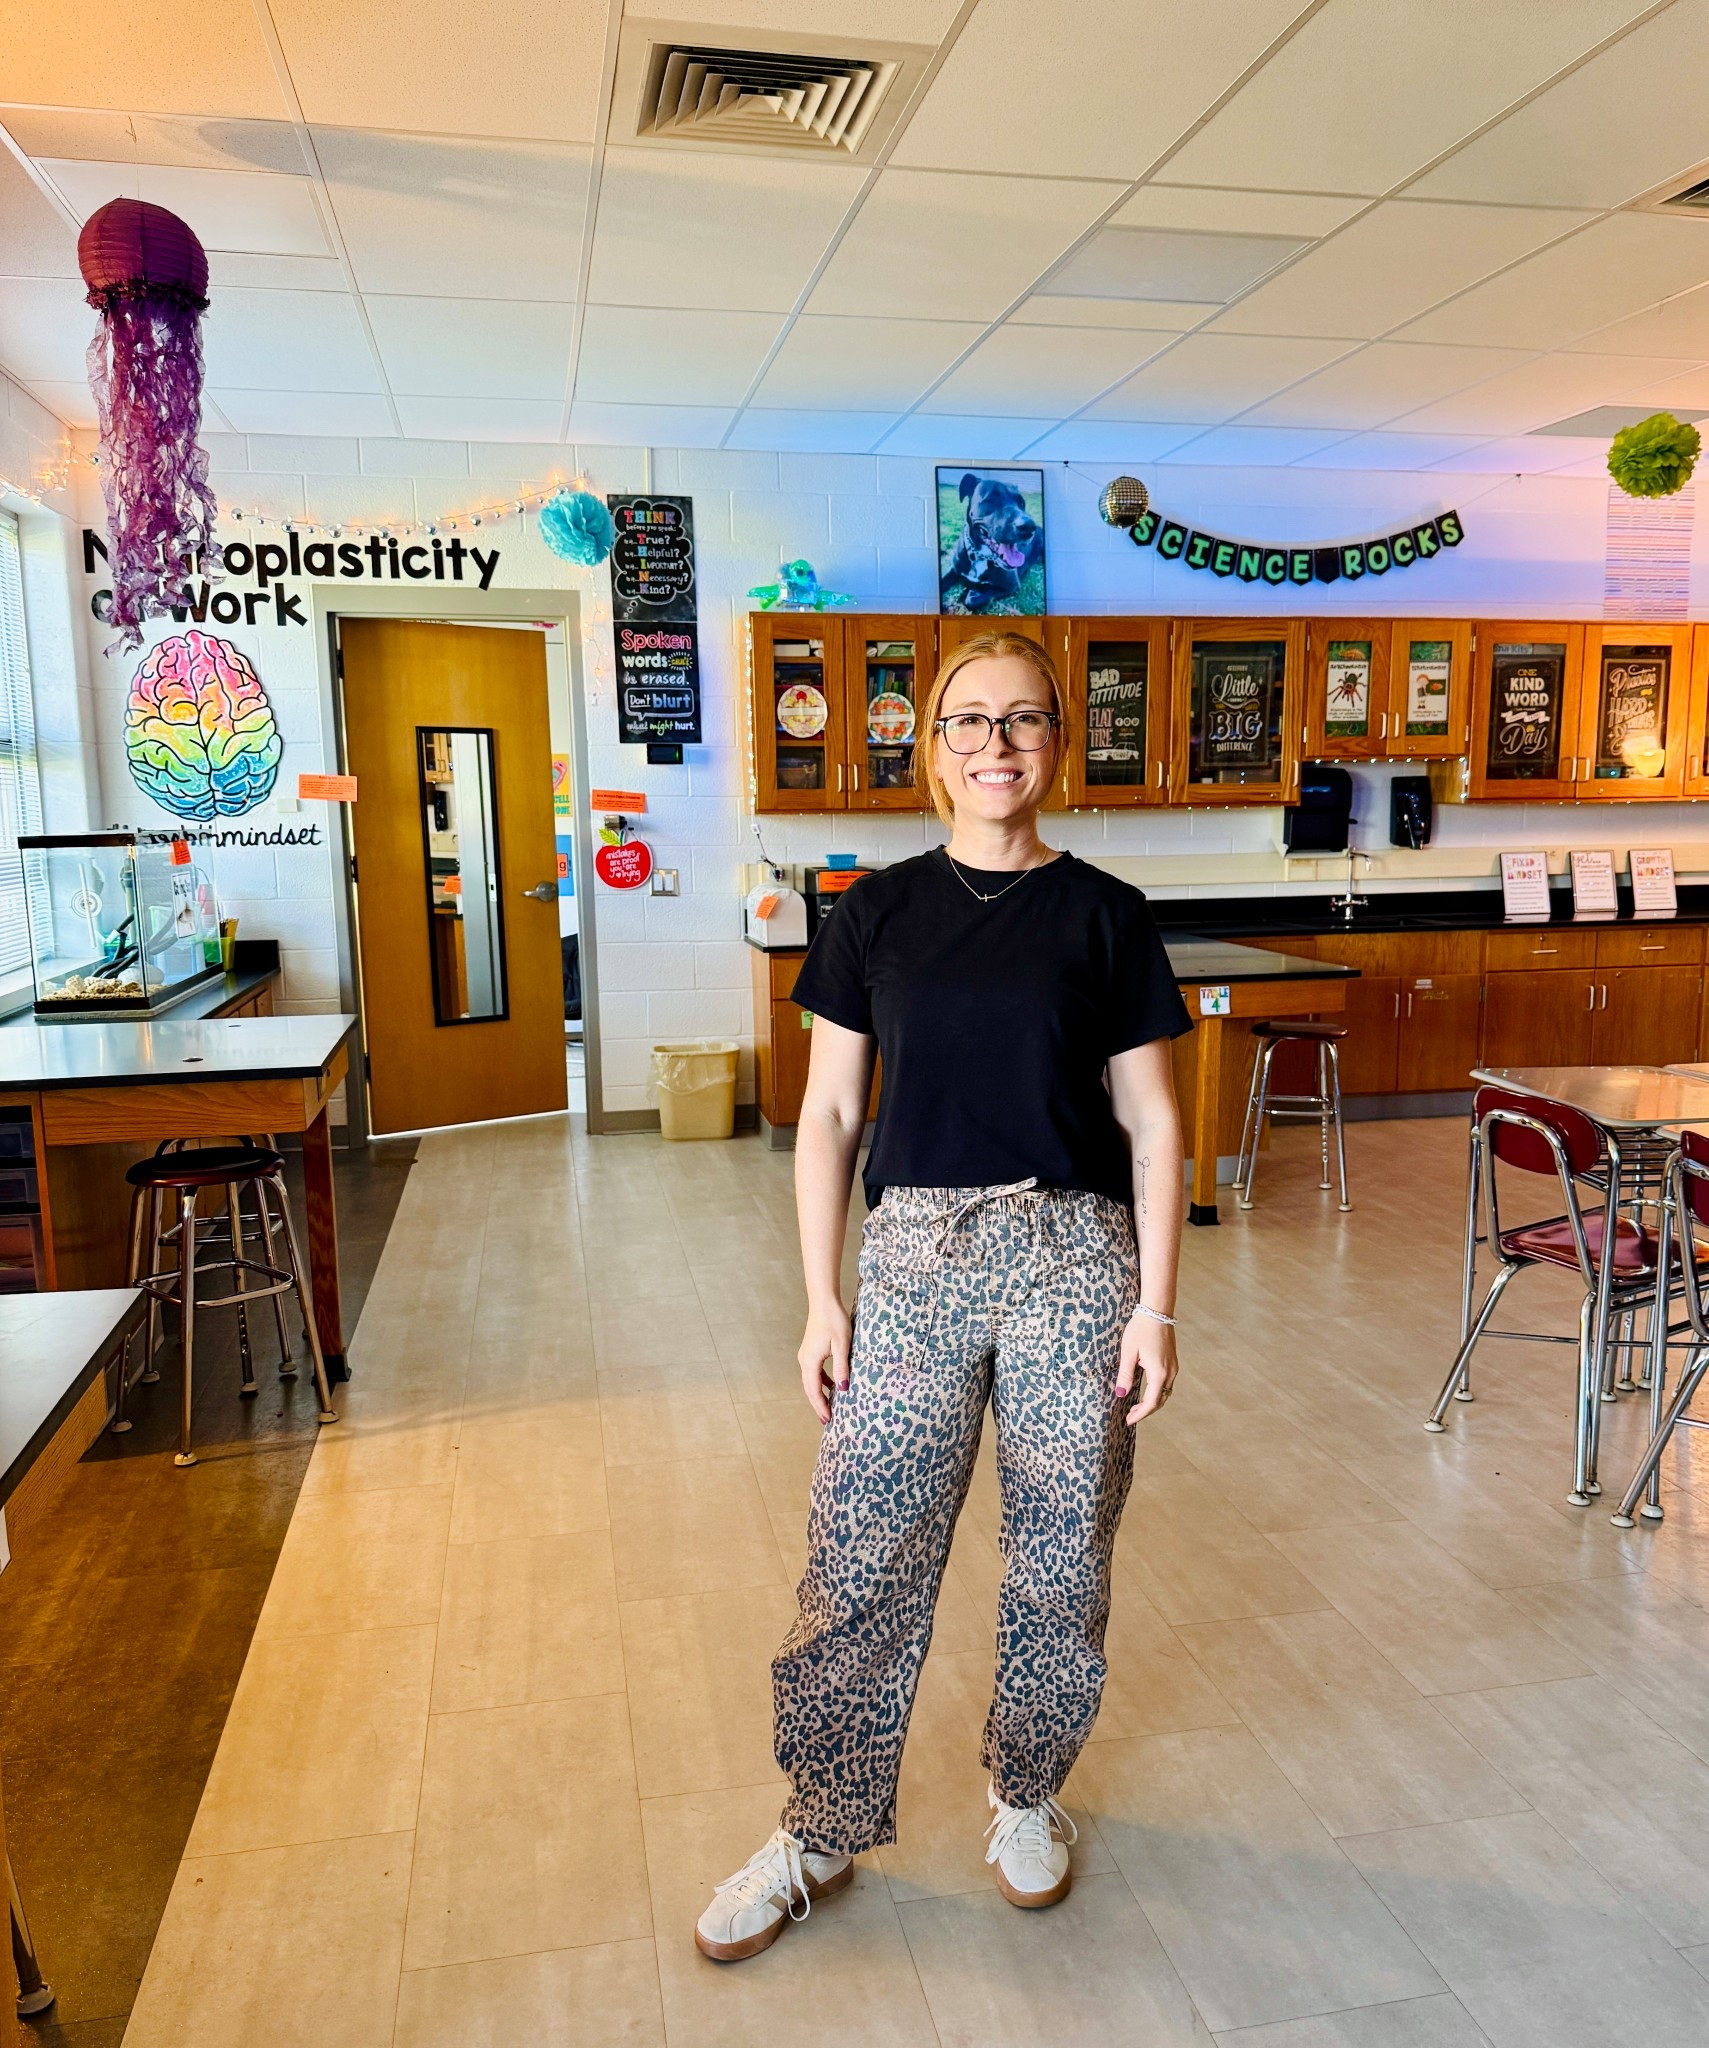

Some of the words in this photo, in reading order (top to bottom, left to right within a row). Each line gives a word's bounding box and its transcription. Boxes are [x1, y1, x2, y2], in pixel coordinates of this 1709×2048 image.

[624, 510, 676, 524] THINK
[637, 533, 671, 545] True?
[638, 546, 680, 559] Helpful?
[1134, 515, 1310, 580] SCIENCE
[1344, 517, 1460, 574] ROCKS
[639, 570, 689, 586] Necessary?
[640, 583, 671, 594] Kind?
[621, 629, 692, 652] Spoken
[621, 652, 668, 668] words
[623, 671, 637, 684] be
[641, 670, 690, 685] erased.
[1090, 668, 1120, 690] BAD
[1510, 677, 1545, 691] KIND
[1088, 681, 1143, 706] ATTITUDE
[1211, 673, 1259, 702] Little
[629, 694, 651, 706] Don't
[653, 693, 690, 708] blurt
[1504, 693, 1549, 707] WORD
[1089, 707, 1114, 728] FLAT
[1209, 710, 1263, 740] BIG
[650, 720, 673, 736] might
[675, 721, 695, 730] hurt.
[1088, 728, 1113, 748] TIRE
[1500, 723, 1548, 755] Day
[606, 849, 635, 860] mistakes
[622, 853, 640, 868] proof
[609, 866, 622, 878] you
[1212, 998, 1221, 1013] 4
